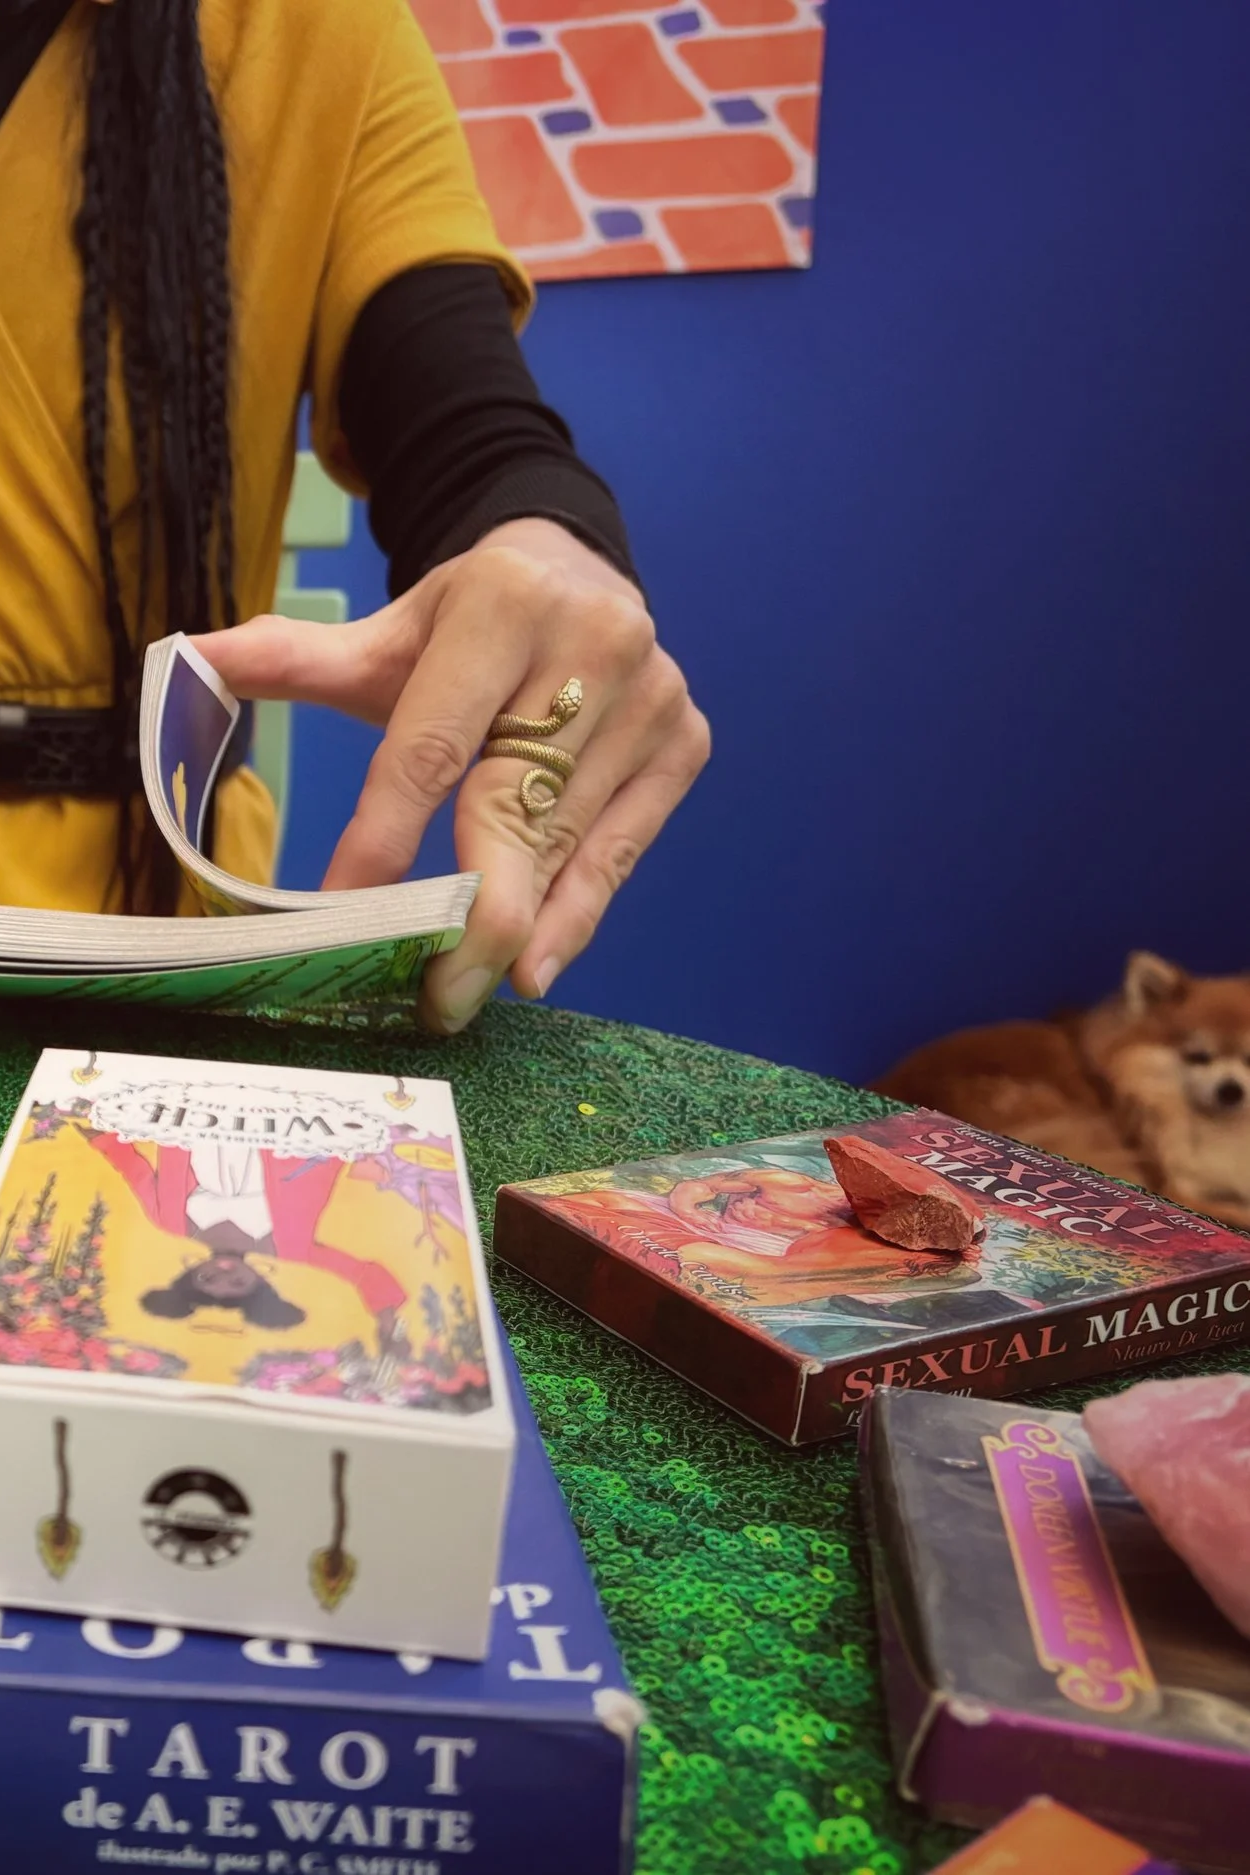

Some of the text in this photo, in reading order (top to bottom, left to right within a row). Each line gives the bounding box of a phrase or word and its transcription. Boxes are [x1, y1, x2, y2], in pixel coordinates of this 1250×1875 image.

[140, 1101, 336, 1137] WITCH
[903, 1150, 1114, 1236] MAGIC
[910, 1131, 1177, 1244] SEXUAL
[953, 1125, 1217, 1236] Laura Tuan Mauro De Luca
[617, 1225, 746, 1297] Oracle Cards
[841, 1279, 1250, 1403] SEXUAL MAGIC
[1110, 1319, 1245, 1365] Mauro De Luca
[69, 1715, 477, 1797] TAROT
[62, 1786, 476, 1854] de A. E. WAITE
[214, 1852, 262, 1875] por
